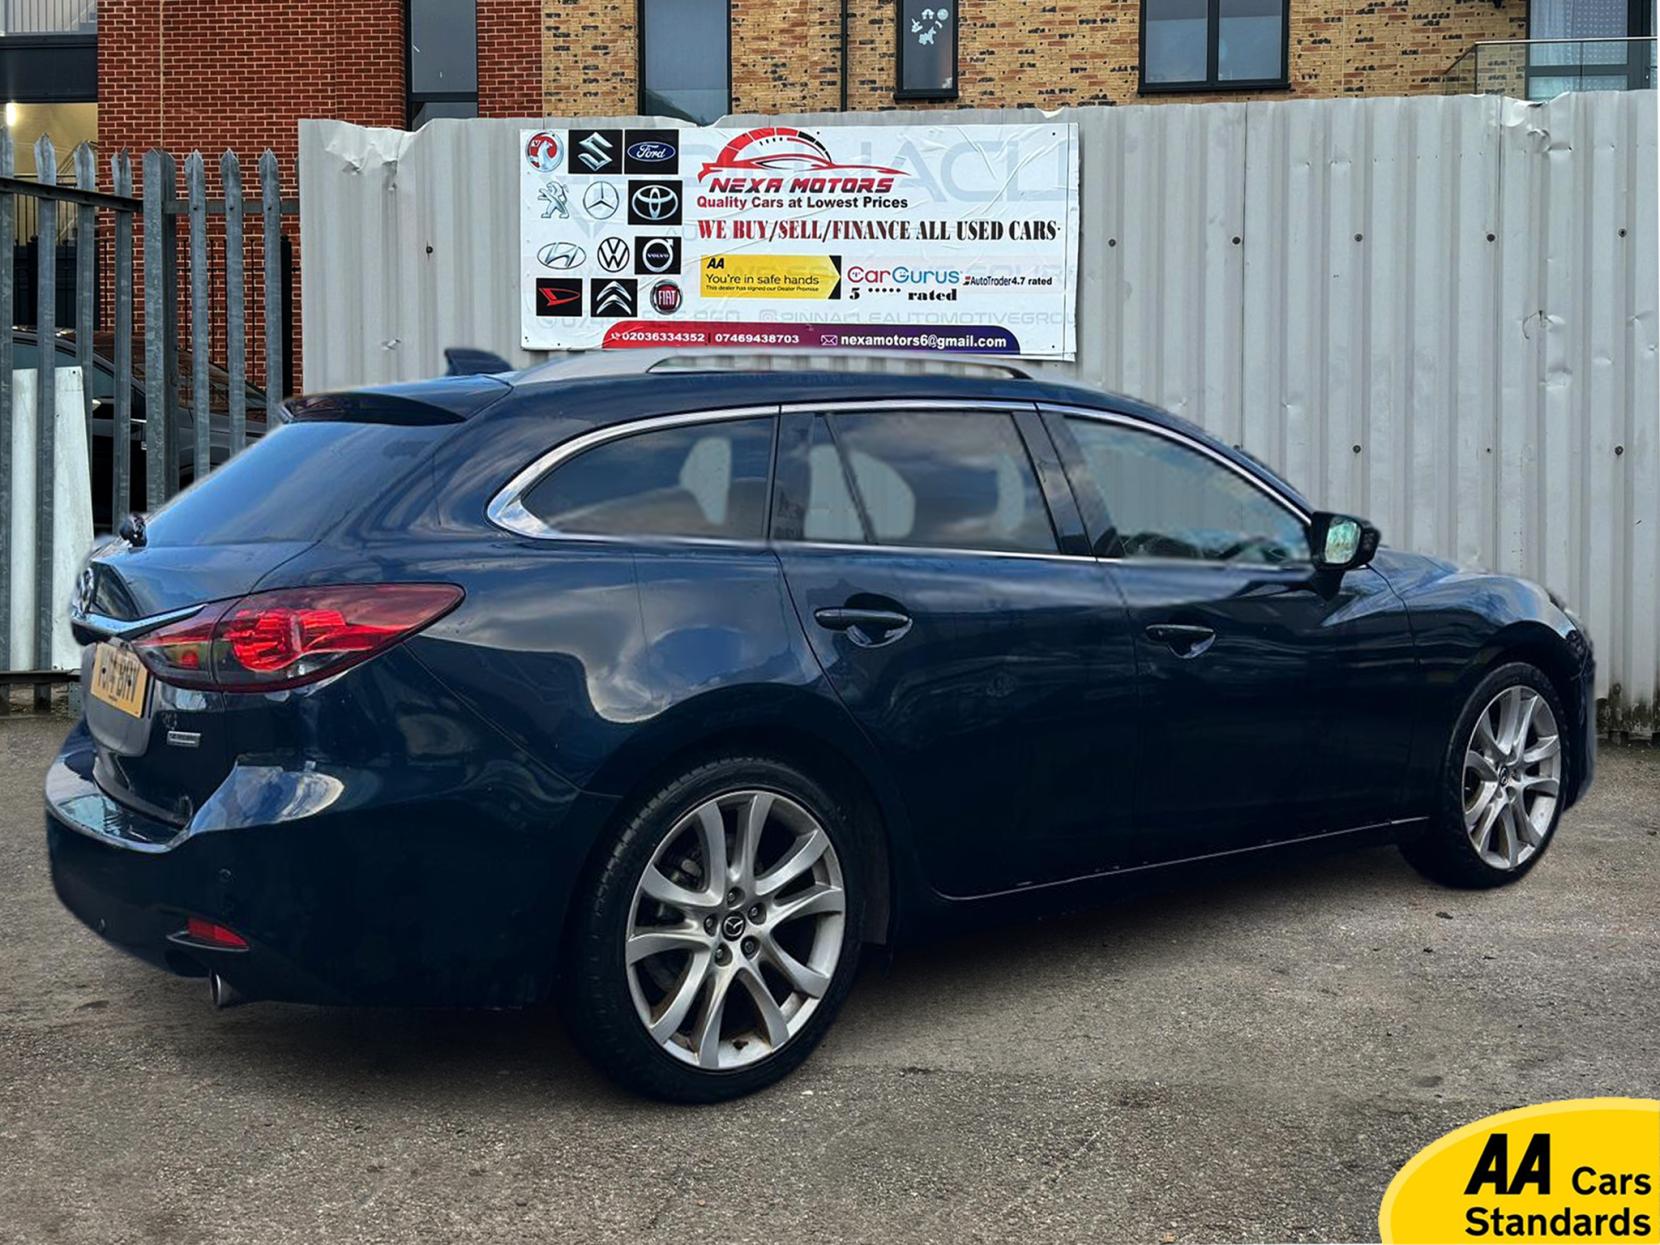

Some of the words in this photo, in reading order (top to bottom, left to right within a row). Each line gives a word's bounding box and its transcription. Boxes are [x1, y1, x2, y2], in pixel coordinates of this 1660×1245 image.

[636, 144, 666, 158] Ford
[709, 177, 784, 193] NEXA
[789, 177, 895, 193] MOTORS
[697, 196, 747, 210] Quality
[751, 196, 784, 208] Cars
[788, 196, 803, 208] at
[807, 196, 858, 208] Lowest
[863, 196, 908, 208] Prices
[697, 219, 727, 240] WE
[916, 219, 951, 241] ALL
[956, 219, 1004, 241] USED
[1009, 219, 1057, 241] CARS
[706, 257, 725, 269] AA
[706, 273, 741, 284] You're
[744, 274, 754, 284] in
[757, 274, 781, 285] safe
[784, 274, 820, 285] hands
[847, 266, 960, 285] CarGurus
[1028, 276, 1053, 286] rated
[658, 290, 677, 305] FIAT
[849, 287, 860, 300] 5
[908, 288, 958, 301] rated
[622, 332, 705, 342] 02036334352
[715, 334, 799, 343] 07469438703
[841, 334, 1007, 349] nexamotors6@gmail.com
